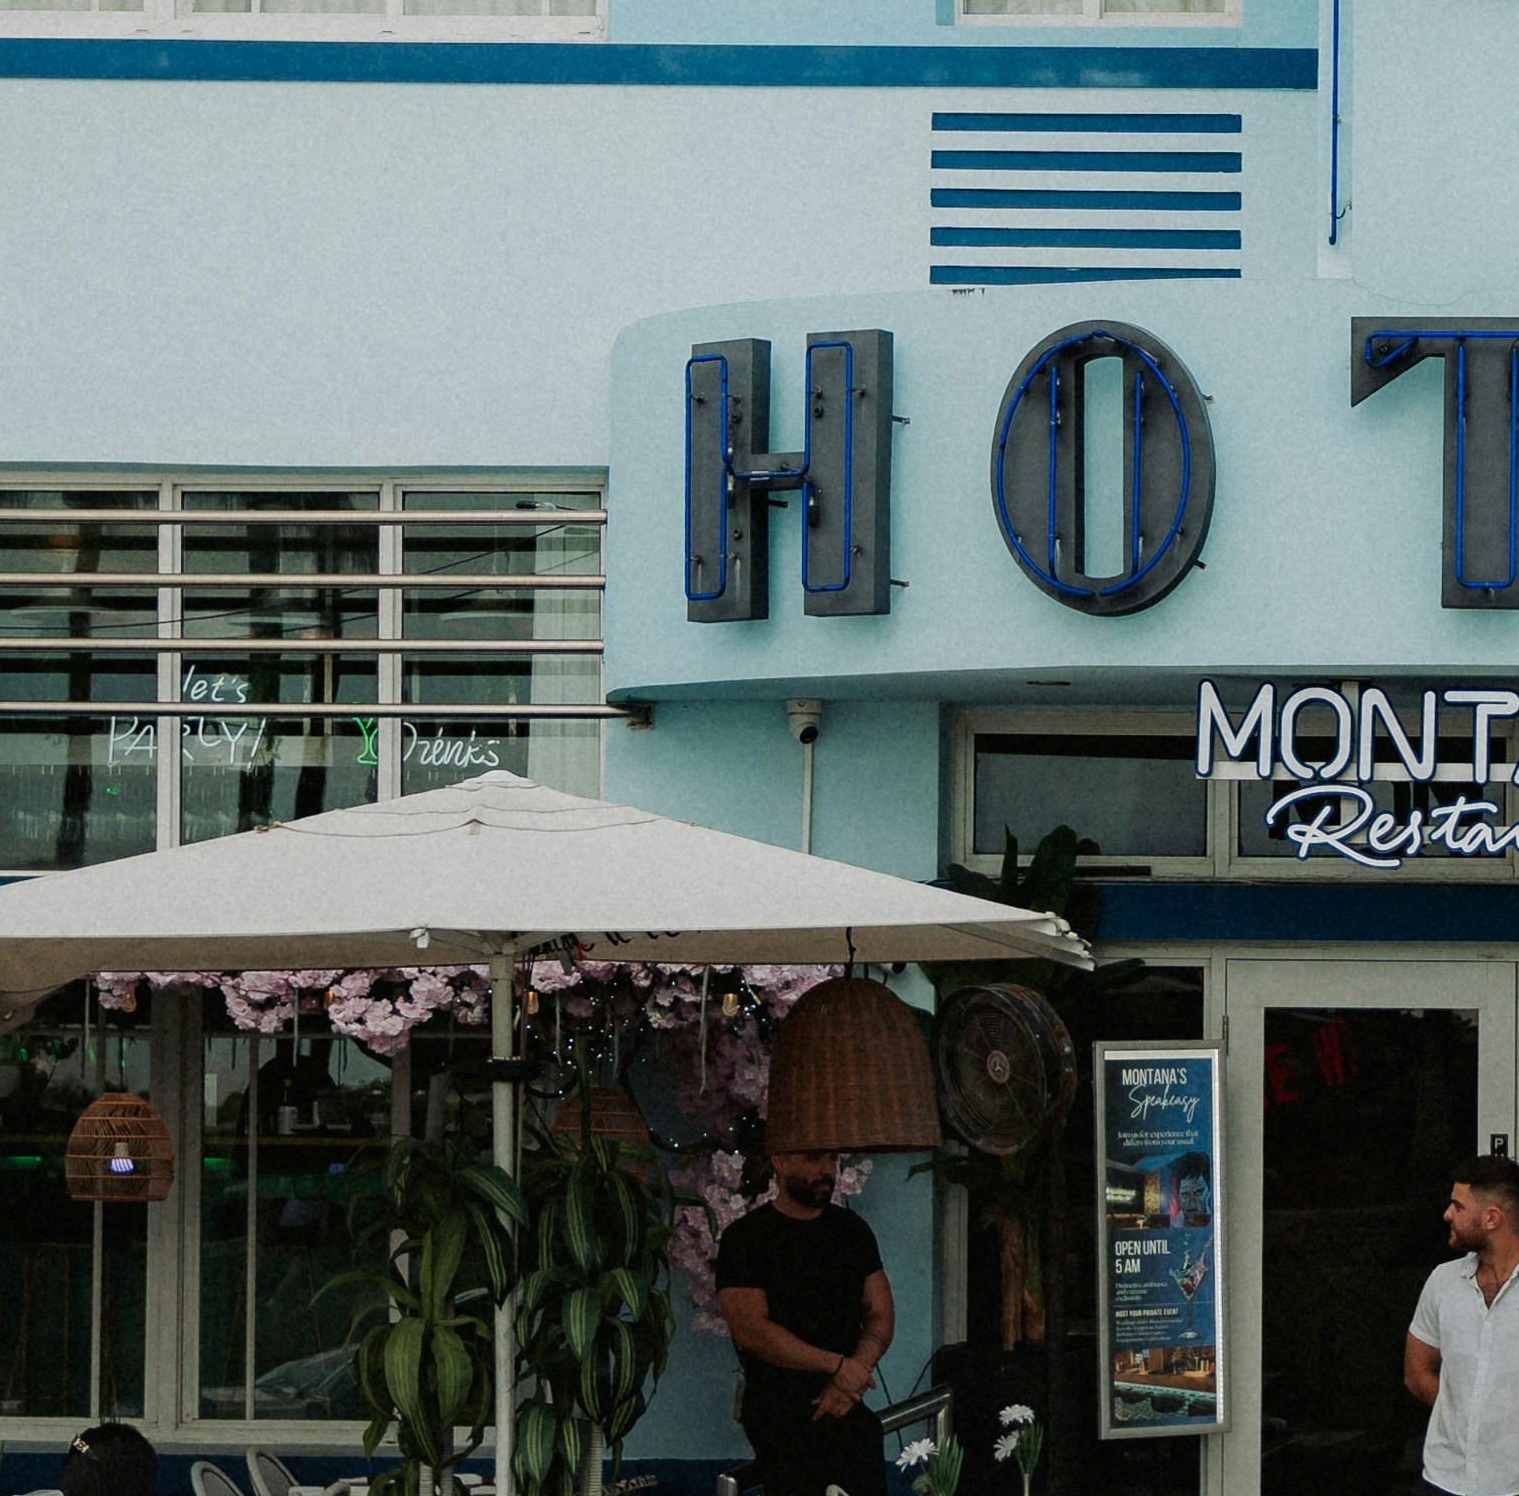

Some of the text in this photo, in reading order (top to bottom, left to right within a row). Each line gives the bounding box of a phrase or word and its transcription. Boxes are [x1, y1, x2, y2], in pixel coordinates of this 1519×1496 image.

[183, 664, 249, 703] let's
[1122, 1067, 1187, 1086] MONTANA'S
[1128, 1083, 1200, 1124] Speakeasy
[1115, 1239, 1170, 1256] OPEN UNTIL
[1115, 1258, 1141, 1274] 5 AM
[1164, 1308, 1179, 1316] EVENT
